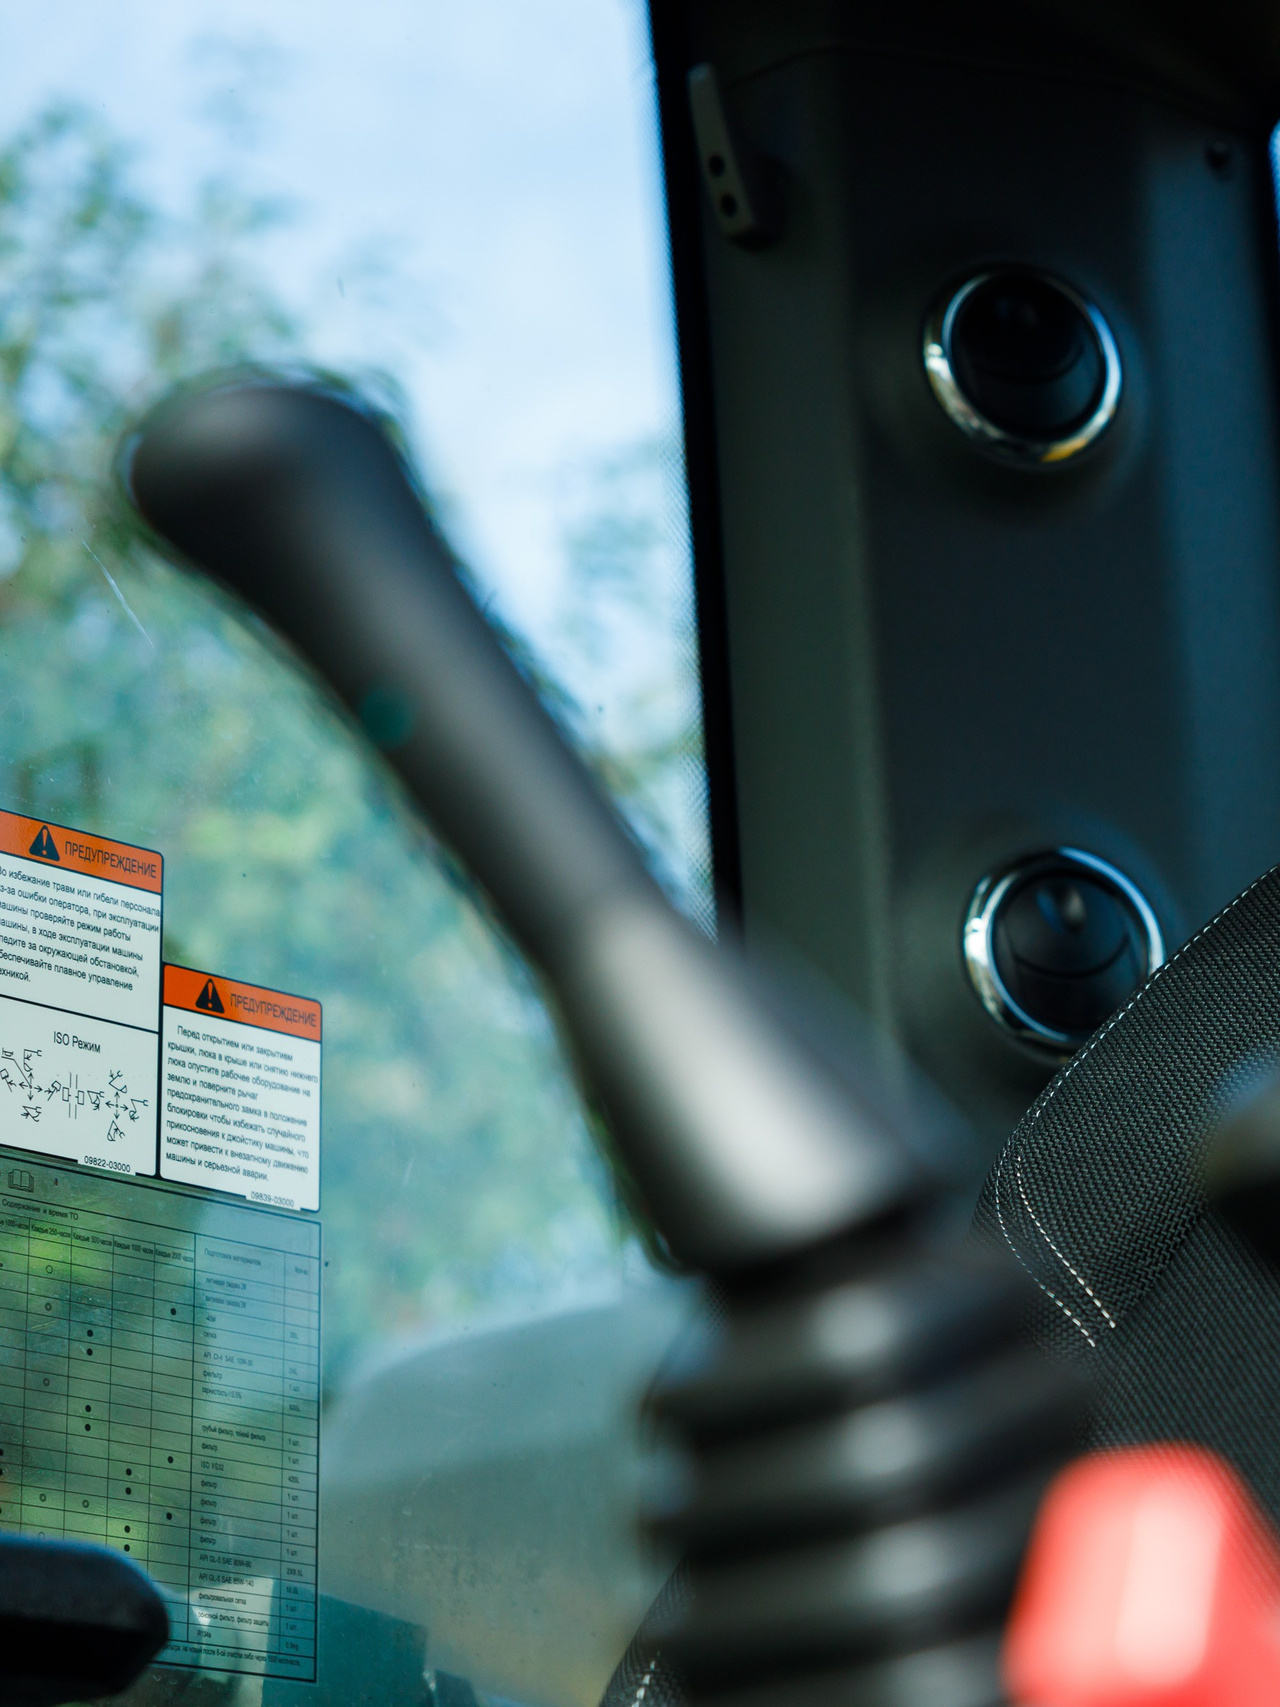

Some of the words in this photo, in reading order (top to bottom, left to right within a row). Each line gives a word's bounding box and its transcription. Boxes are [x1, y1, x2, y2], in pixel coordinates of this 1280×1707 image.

[65, 841, 157, 878] ПРЕДУПРЕЖДЕНИЕ
[0, 885, 15, 895] з-за
[18, 890, 46, 903] ошибки
[49, 898, 90, 916] оператора,
[93, 909, 106, 919] при
[109, 914, 160, 933] эксплуатации
[9, 871, 50, 888] избежание
[53, 882, 75, 894] травм
[77, 889, 91, 898] или
[94, 893, 118, 905] гибели
[121, 900, 160, 917] персонала
[0, 919, 29, 933] ашины,
[39, 929, 56, 939] ходе
[59, 934, 109, 952] эксплуатации
[112, 947, 142, 960] машины
[31, 910, 74, 927] проверяйте
[77, 922, 101, 933] режим
[104, 928, 130, 941] работы
[0, 935, 26, 948] ледите
[28, 942, 36, 950] за
[39, 945, 87, 963] окружающей
[90, 957, 138, 977] обстановкой,
[0, 949, 52, 970] беспечивайте
[54, 965, 86, 979] плавное
[88, 974, 132, 990] управление
[0, 968, 30, 981] ехникой.
[230, 994, 317, 1027] ПРЕДУПРЕЖДЕНИЕ
[53, 1031, 69, 1046] ISO
[72, 1036, 101, 1053] Режим
[178, 1025, 200, 1040] Перед
[202, 1034, 239, 1048] открытием
[256, 1047, 292, 1061] закрытием
[168, 1042, 196, 1055] крышки,
[199, 1049, 216, 1059] люка
[224, 1056, 247, 1066] крыше
[264, 1065, 288, 1076] снятию
[291, 1072, 318, 1084] нижнего
[168, 1057, 186, 1068] люка
[188, 1062, 219, 1075] опустите
[221, 1070, 250, 1082] рабочее
[252, 1076, 300, 1094] оборудование
[167, 1073, 190, 1085] землю
[200, 1080, 235, 1095] поверните
[238, 1089, 258, 1100] рычаг
[167, 1089, 239, 1111] предохранительного
[242, 1106, 261, 1116] замка
[270, 1112, 307, 1127] положение
[167, 1103, 207, 1119] блокировки
[210, 1115, 231, 1125] чтобы
[233, 1119, 265, 1133] избежать
[267, 1127, 305, 1142] случайного
[167, 1120, 219, 1137] прикосновения
[227, 1134, 263, 1150] джойстику
[265, 1143, 295, 1156] машины,
[297, 1150, 309, 1158] что
[167, 1136, 189, 1146] может
[191, 1142, 223, 1154] привести
[230, 1150, 271, 1167] внезапному
[273, 1160, 308, 1173] движению
[84, 1156, 131, 1173] 09822-03000
[166, 1153, 195, 1165] машины
[204, 1161, 240, 1174] серьезной
[242, 1169, 267, 1180] аварии.
[2, 1199, 41, 1213] Содержание
[48, 1209, 68, 1219] время
[69, 1211, 79, 1220] ТО
[250, 1191, 294, 1208] 09839-03000
[201, 1461, 210, 1469] ISO
[221, 1576, 232, 1584] SAE
